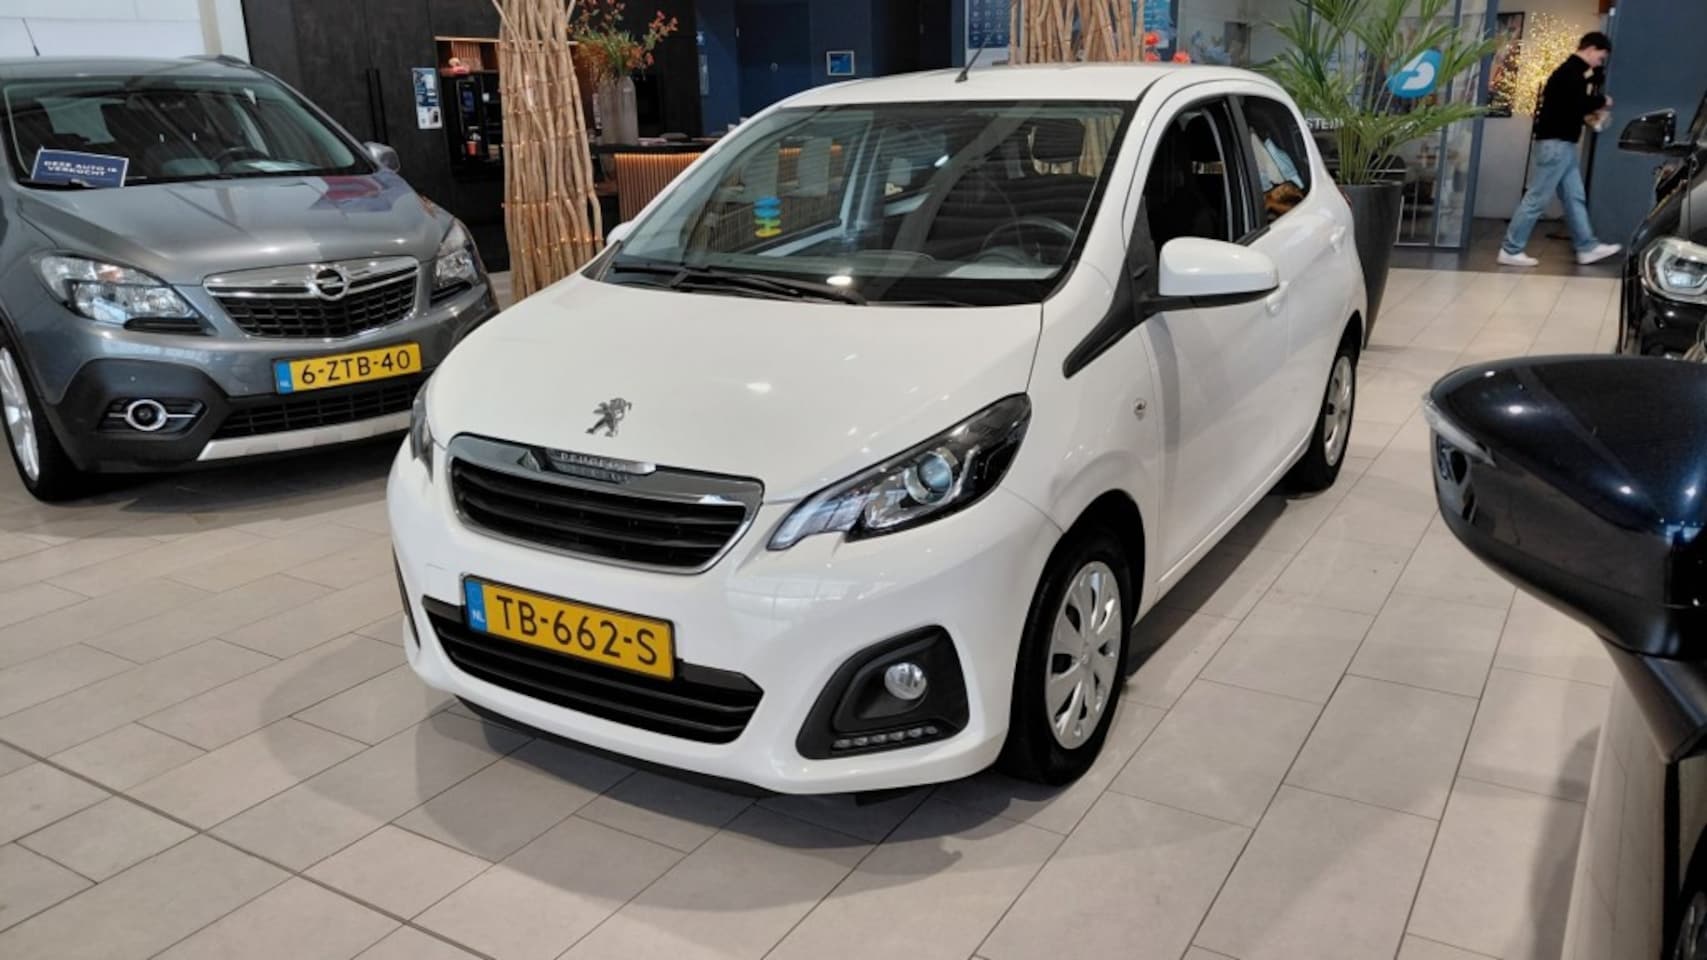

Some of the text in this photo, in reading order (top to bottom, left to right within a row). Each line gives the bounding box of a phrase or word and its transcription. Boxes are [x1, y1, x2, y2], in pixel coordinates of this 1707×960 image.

[47, 166, 106, 176] VERKOCHT
[75, 163, 105, 171] AUTO
[301, 350, 411, 384] 6-ZTB-40
[472, 609, 485, 623] NL
[496, 595, 657, 666] TB-662-S
